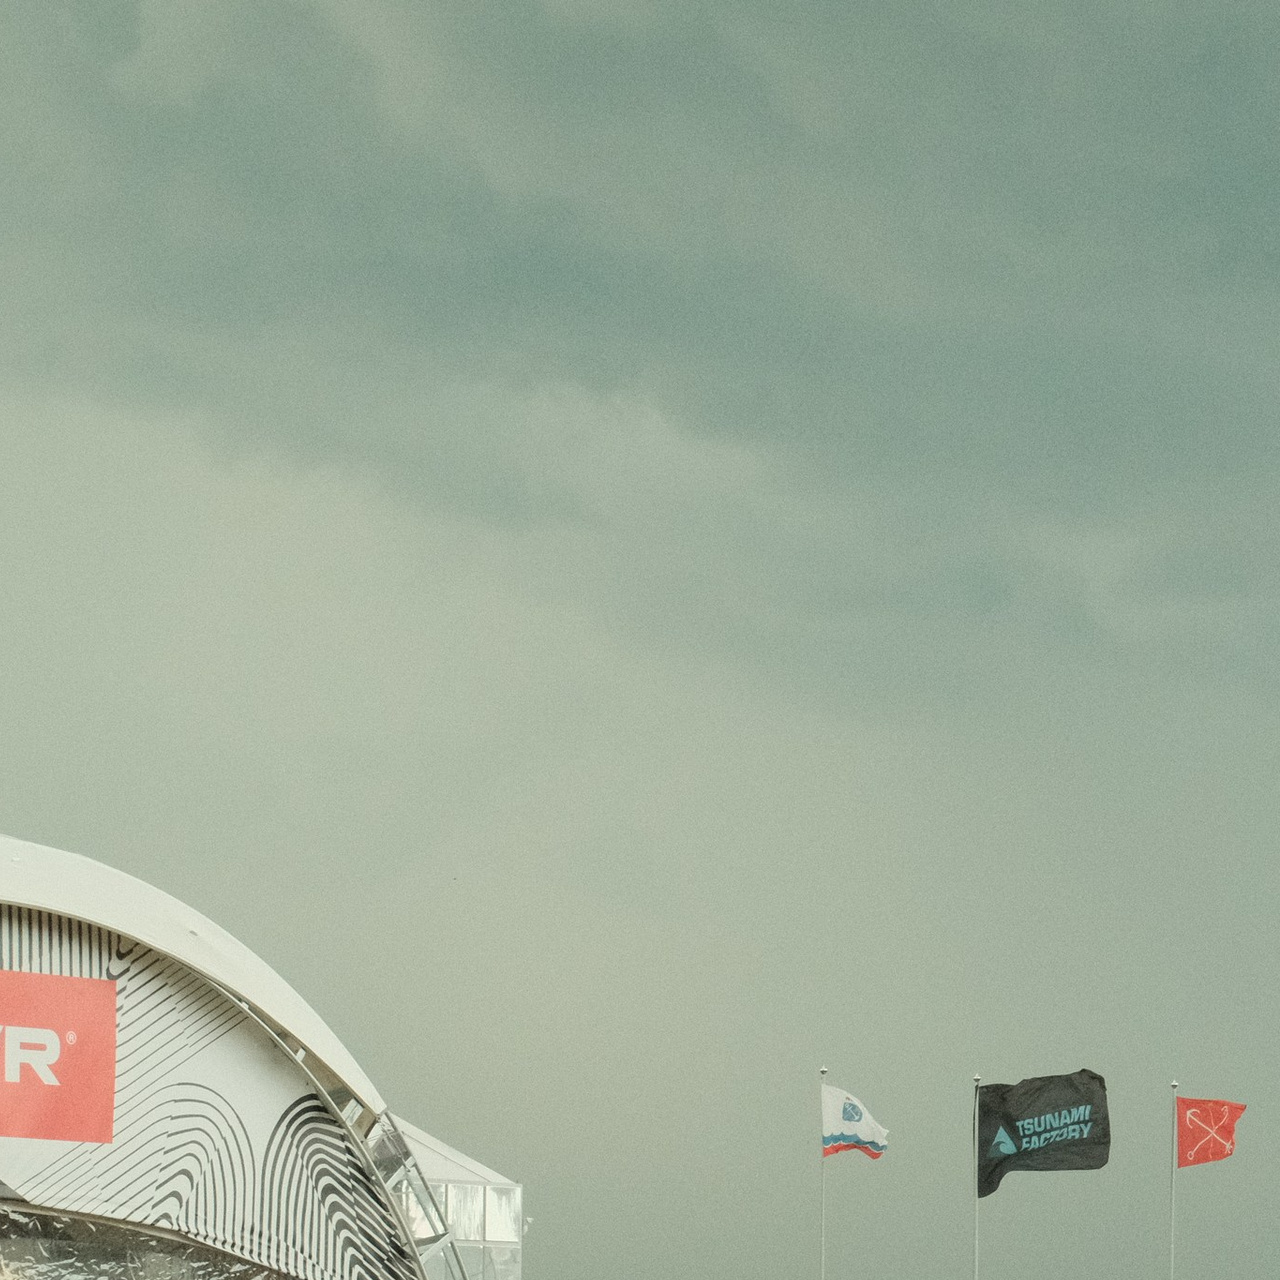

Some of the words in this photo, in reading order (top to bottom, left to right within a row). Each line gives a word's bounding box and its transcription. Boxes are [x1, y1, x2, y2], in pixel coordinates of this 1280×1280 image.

[0, 1024, 61, 1086] R
[1016, 1104, 1092, 1136] TSUNAMI
[1020, 1122, 1093, 1151] FACTORY
